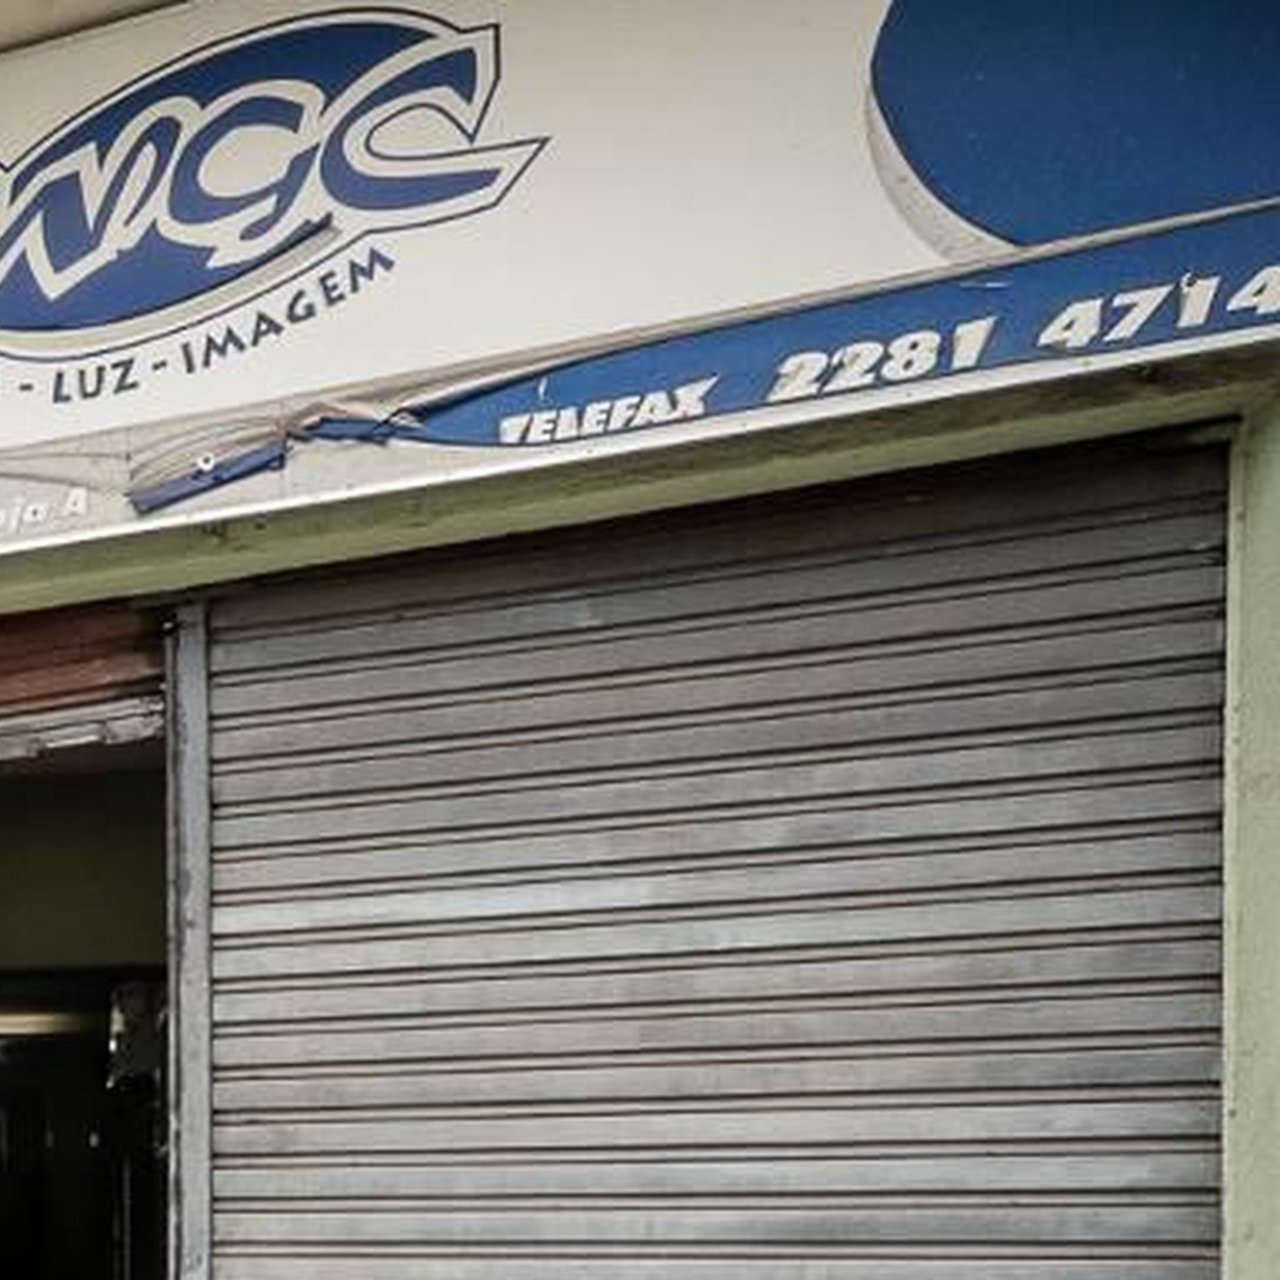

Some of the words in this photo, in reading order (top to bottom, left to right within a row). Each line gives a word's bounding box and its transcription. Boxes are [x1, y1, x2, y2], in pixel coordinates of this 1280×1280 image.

[52, 358, 140, 403] LUZ
[181, 247, 396, 375] IMAGEM
[498, 374, 720, 444] TELEFAX
[766, 316, 998, 403] 2281
[1037, 264, 1280, 348] 4714
[64, 486, 89, 516] A
